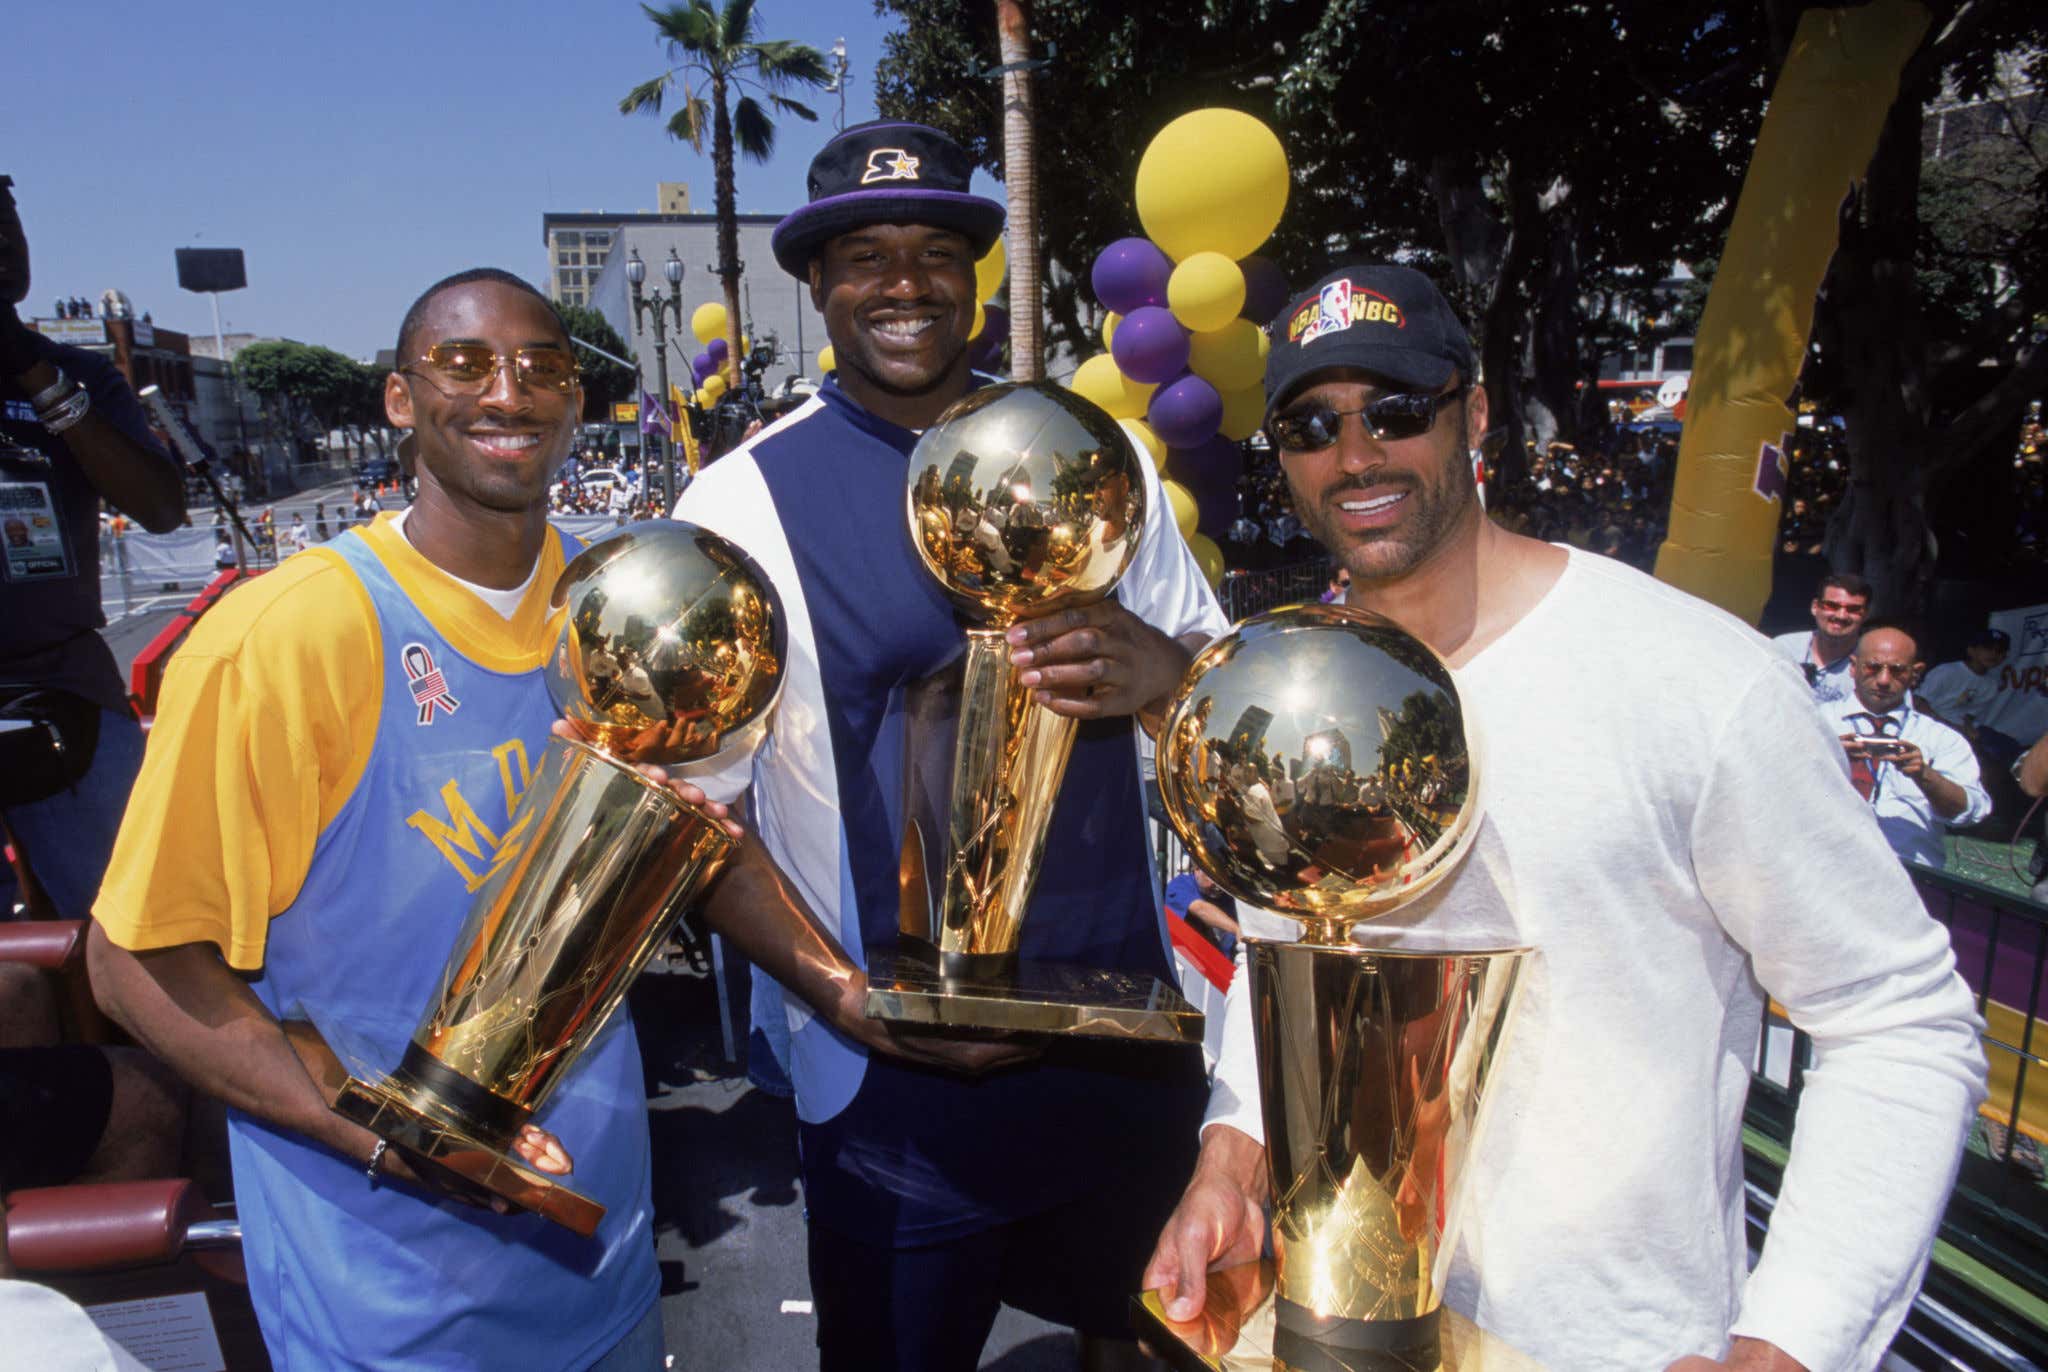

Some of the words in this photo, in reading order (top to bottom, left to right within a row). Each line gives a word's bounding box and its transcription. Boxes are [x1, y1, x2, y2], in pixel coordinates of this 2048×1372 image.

[1351, 293, 1366, 303] on
[1289, 304, 1320, 342] NBA
[1350, 300, 1399, 323] NBC
